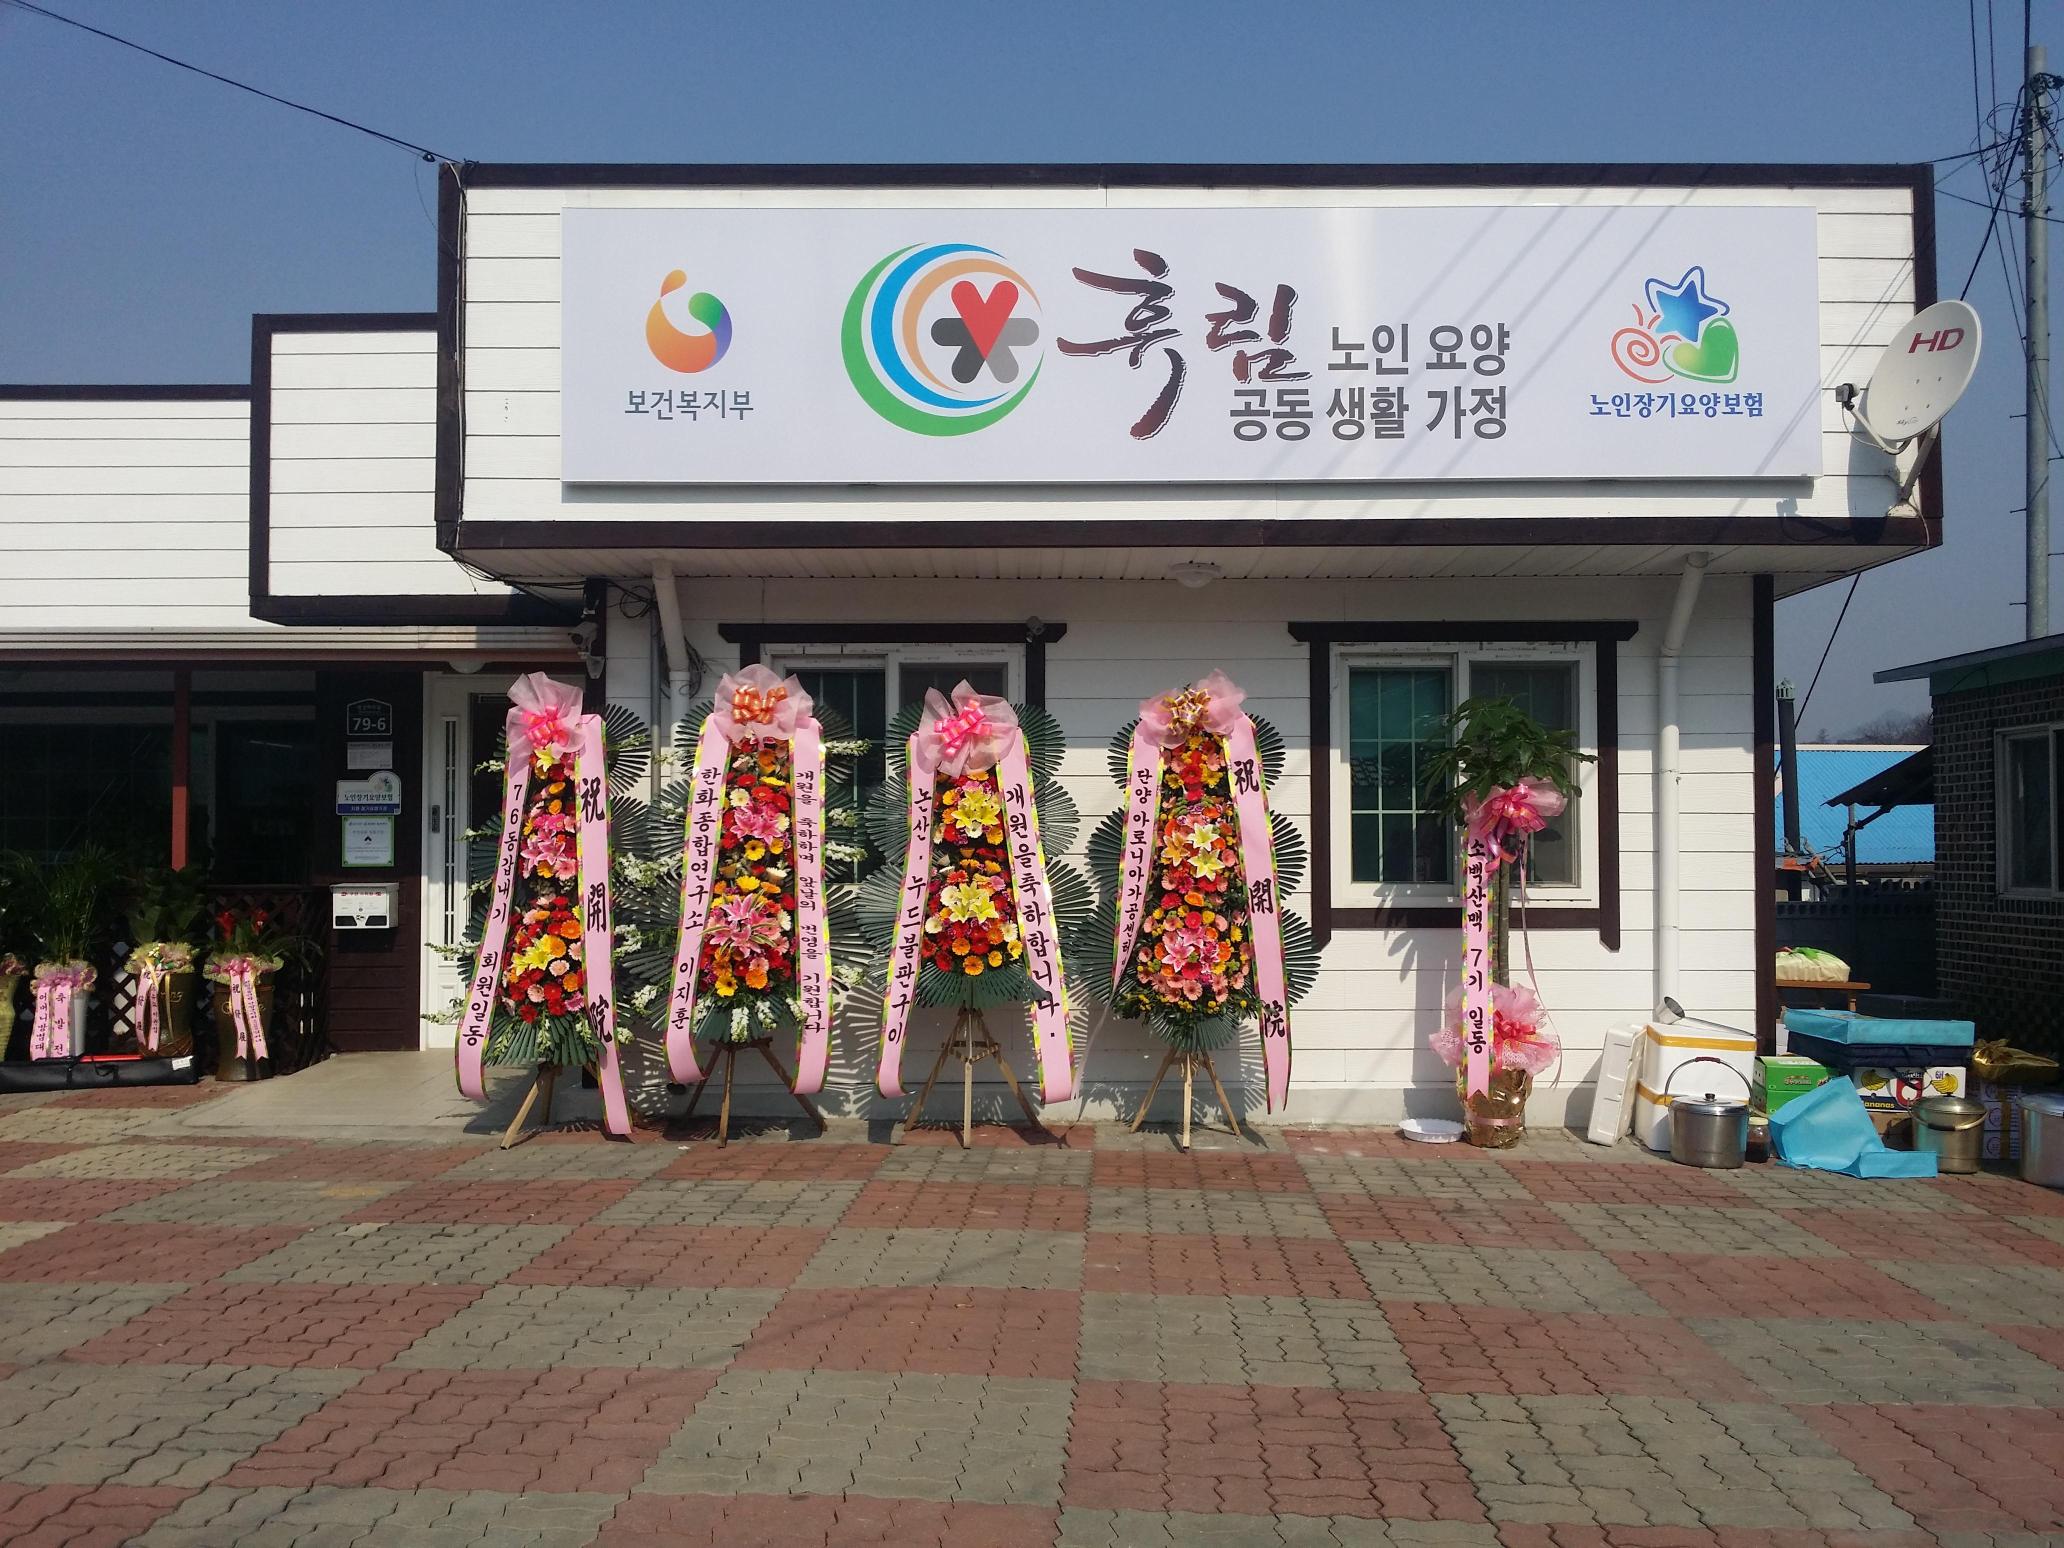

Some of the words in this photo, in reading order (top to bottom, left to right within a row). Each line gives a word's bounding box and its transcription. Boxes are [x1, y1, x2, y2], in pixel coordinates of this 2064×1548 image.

[1327, 322, 1410, 375] 노인
[1425, 321, 1511, 375] 요양
[1908, 327, 1965, 354] HD
[624, 389, 754, 421] 보건복지부
[1228, 386, 1312, 442] 공동
[1326, 385, 1409, 442] 생활
[1426, 385, 1509, 442] 가정
[1588, 392, 1764, 419] 노인장기요양보험
[352, 717, 387, 731] 79-6
[796, 770, 817, 805] 개원을
[911, 787, 934, 841] 논산
[490, 783, 525, 925] 76동갑내기
[684, 767, 722, 931] 한화종합연구소
[797, 817, 818, 864] 축하하며
[799, 876, 818, 911] 앞날의
[1467, 838, 1487, 933] 소백산맥
[801, 924, 822, 959] 번영을
[887, 875, 929, 1045] 누드불판구이
[671, 957, 695, 1030] 이지훈
[1469, 948, 1485, 992] 7기
[461, 951, 499, 1048] 회원일동
[802, 972, 825, 1034] 기원합니다
[1467, 1006, 1487, 1055] 일동
[1863, 1101, 1895, 1109] ananas
